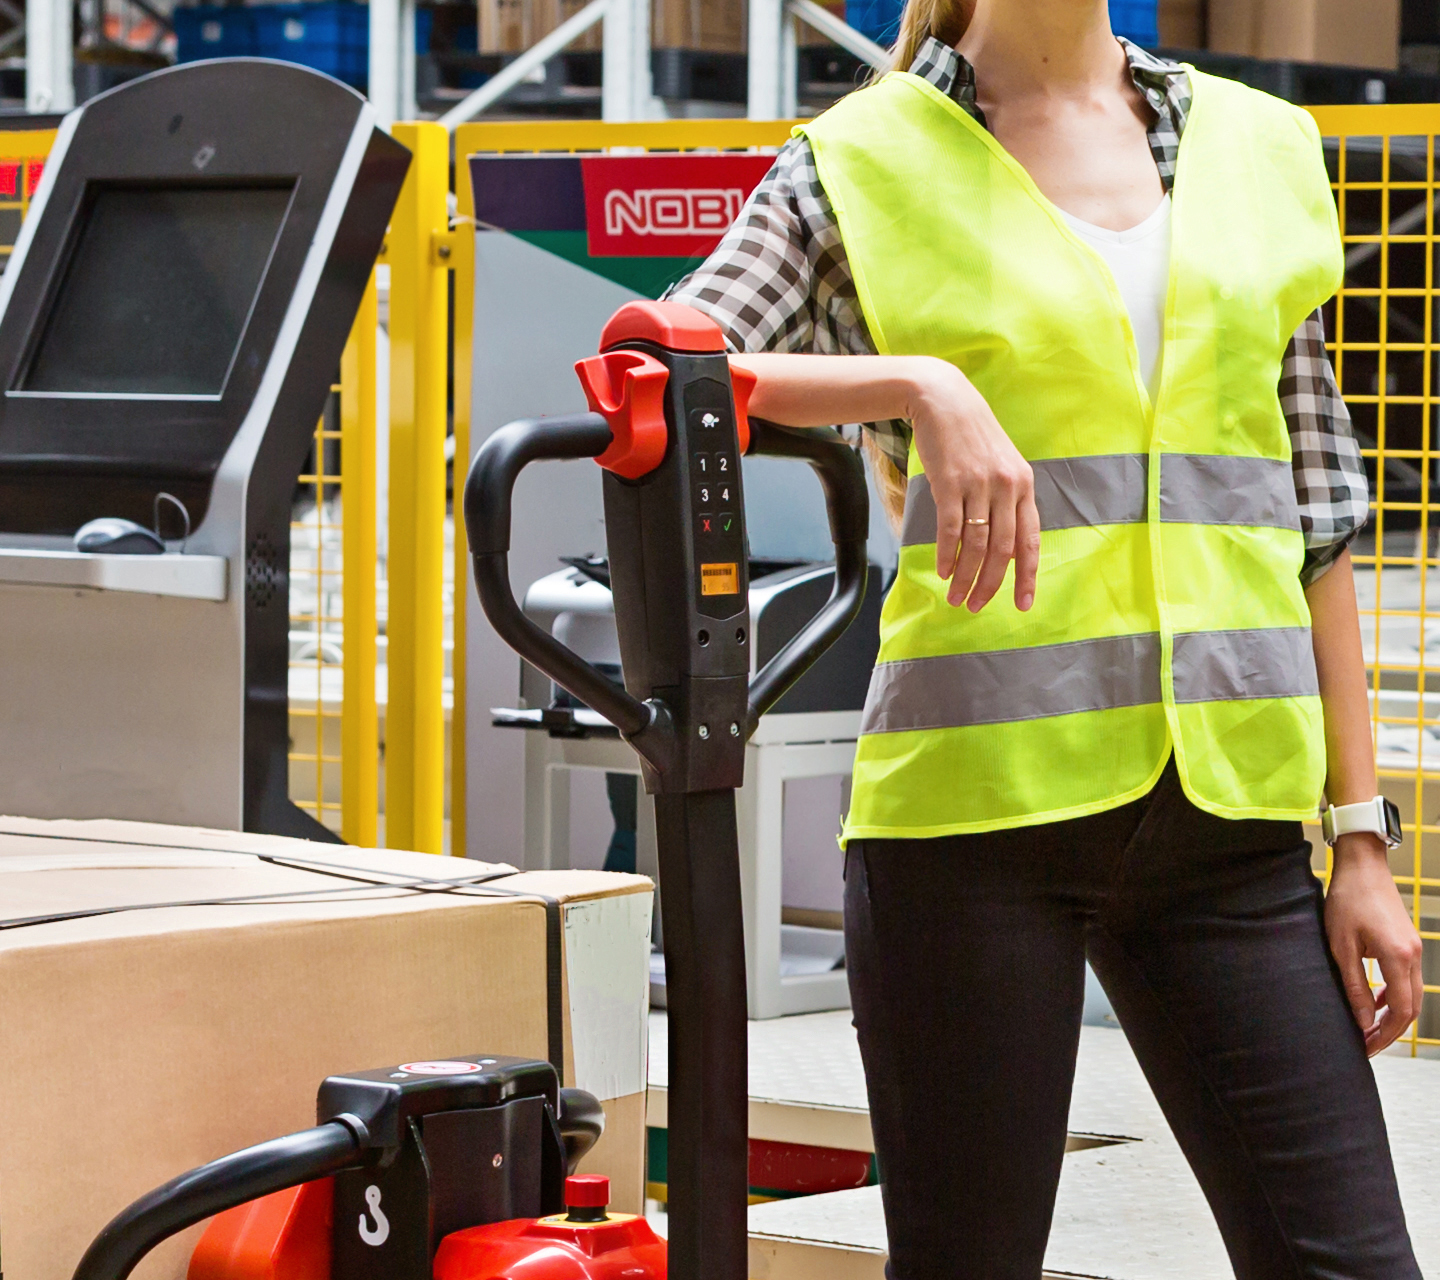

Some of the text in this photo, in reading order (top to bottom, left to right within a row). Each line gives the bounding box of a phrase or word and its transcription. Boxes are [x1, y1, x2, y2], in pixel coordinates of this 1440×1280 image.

[700, 458, 728, 472] 1 2
[701, 488, 730, 502] 3 4
